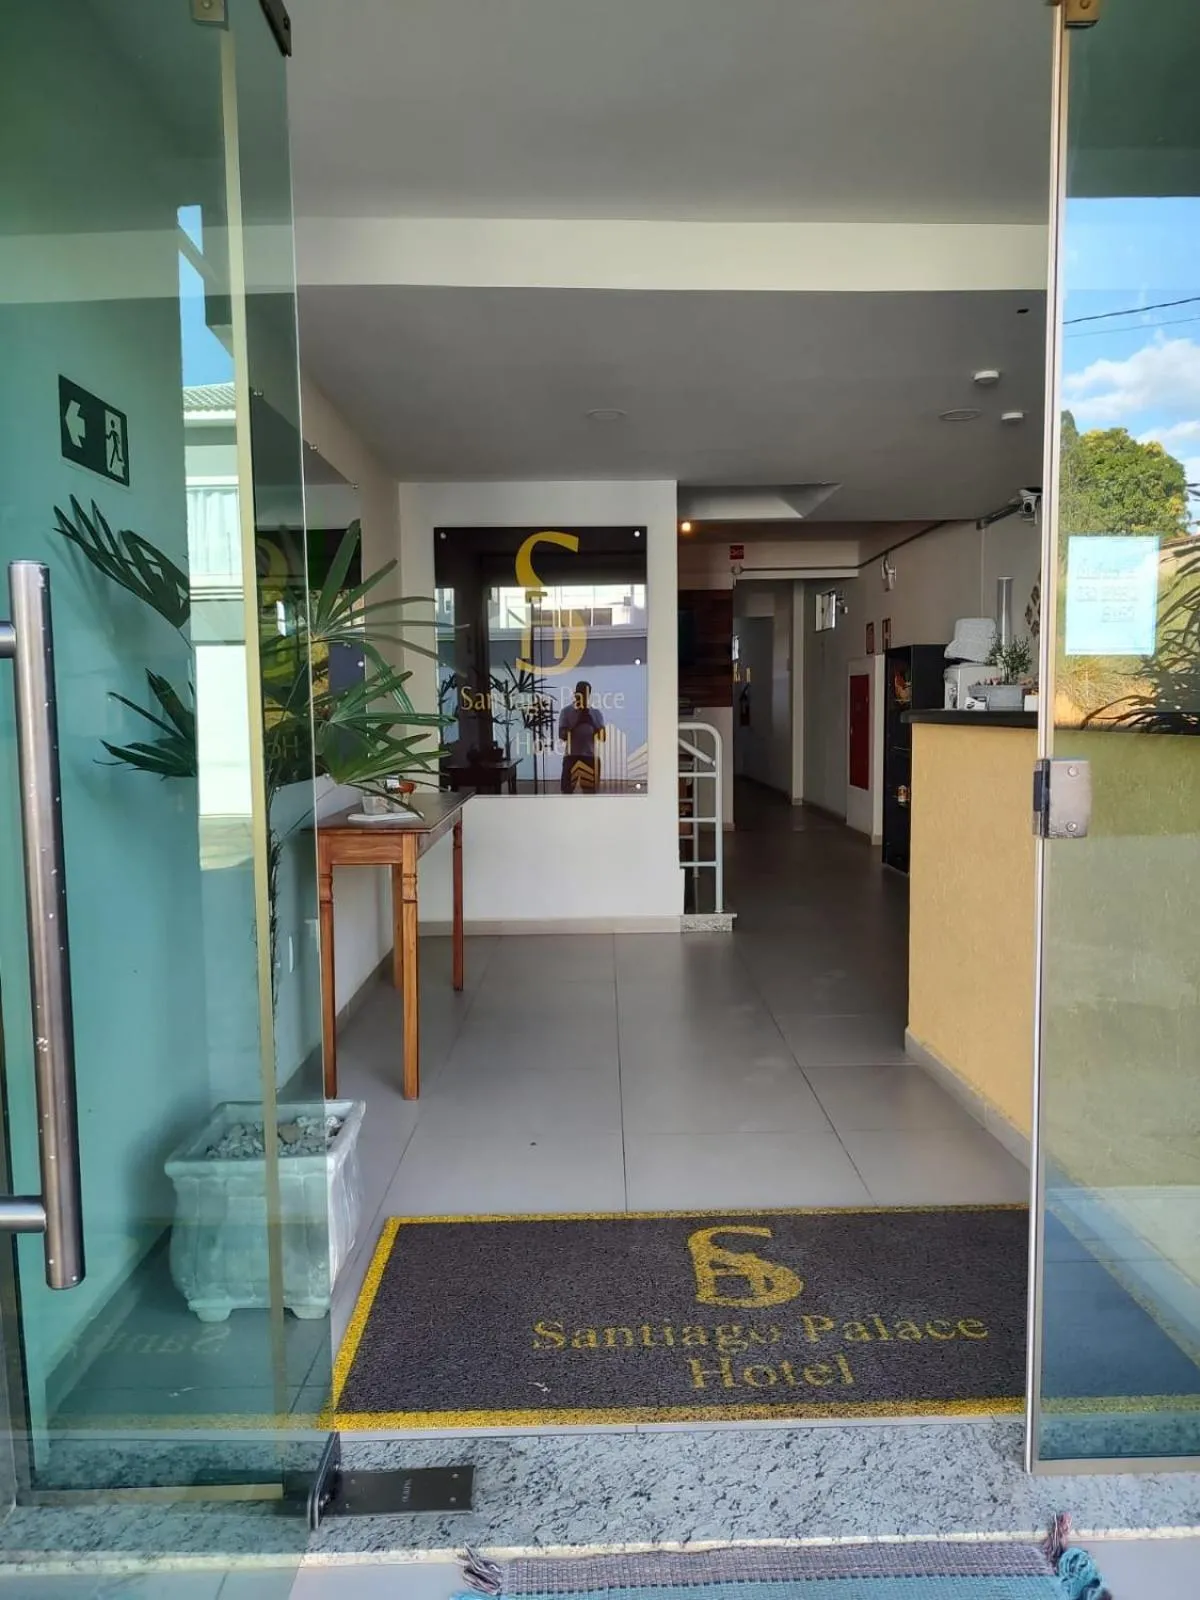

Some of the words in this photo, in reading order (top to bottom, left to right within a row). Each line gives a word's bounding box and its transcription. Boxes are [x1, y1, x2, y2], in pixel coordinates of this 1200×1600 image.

[460, 686, 550, 717] Santiago
[560, 686, 625, 710] Palace
[516, 731, 571, 756] Hotel
[532, 1319, 783, 1355] Santiago
[800, 1313, 989, 1343] Palace
[688, 1352, 855, 1390] Hotel
